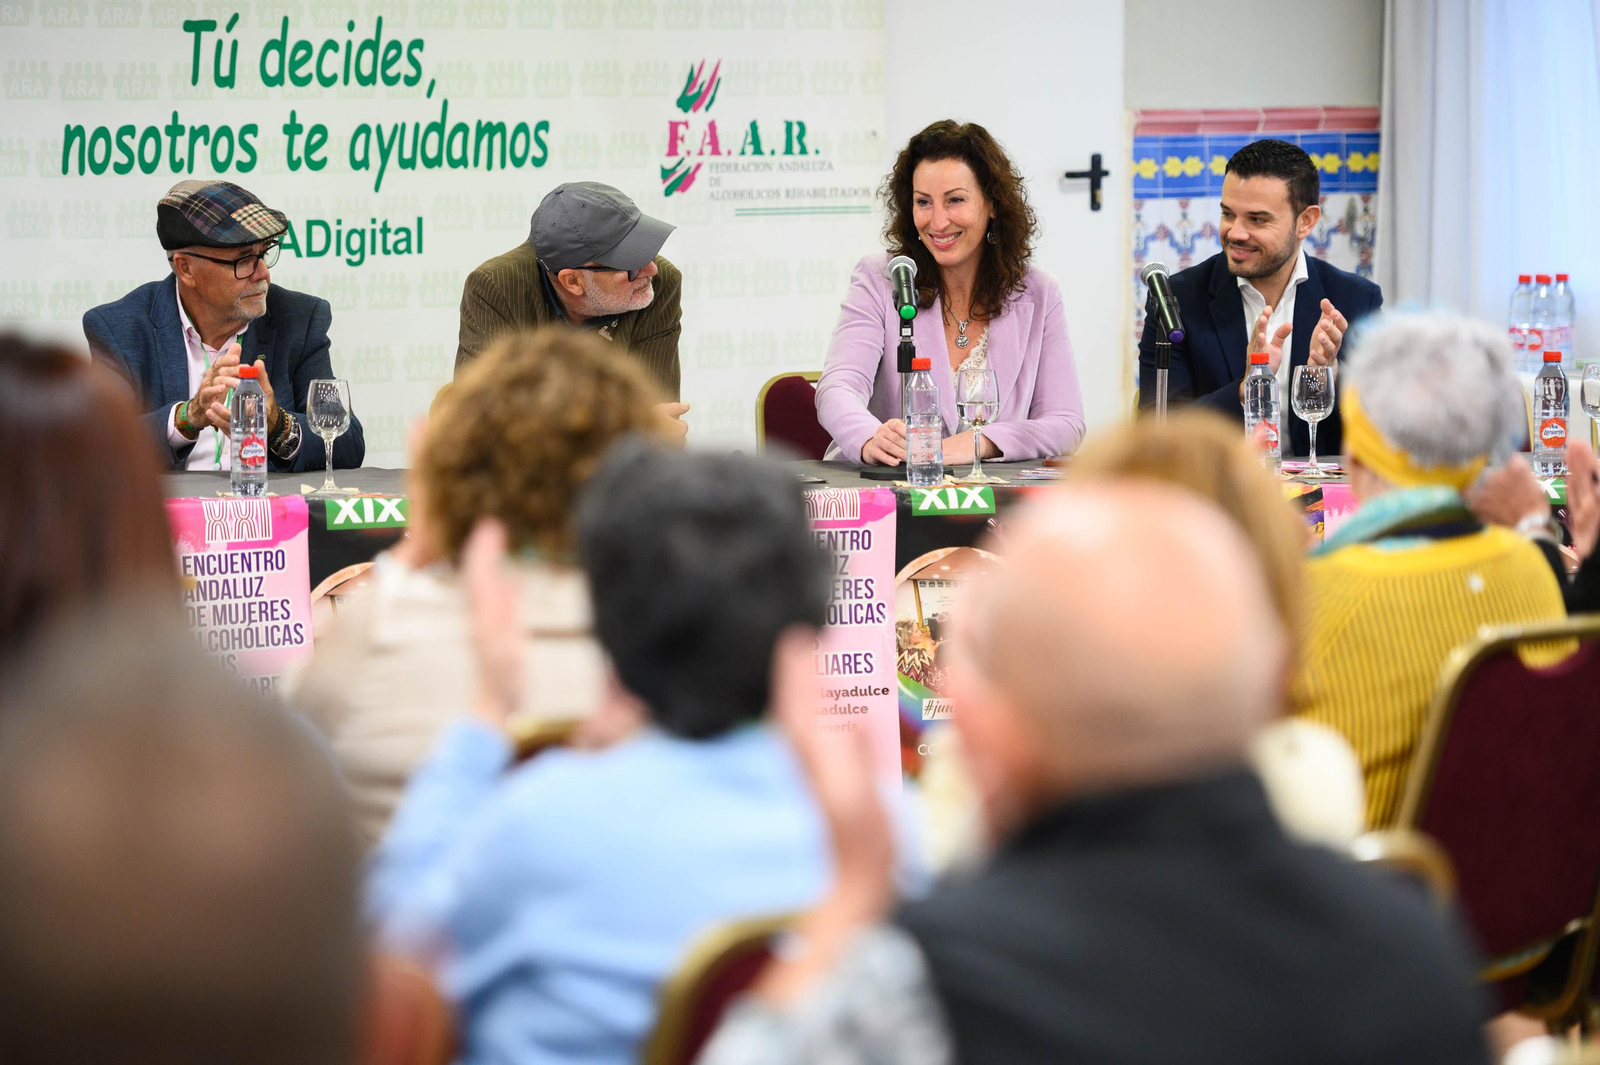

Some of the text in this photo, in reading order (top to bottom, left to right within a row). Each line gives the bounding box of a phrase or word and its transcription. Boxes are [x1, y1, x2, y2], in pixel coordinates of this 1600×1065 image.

[0, 5, 26, 23] RA
[45, 6, 81, 24] ARA
[100, 7, 135, 24] ARA
[183, 13, 437, 99] Tú decides,
[9, 78, 45, 96] ARA
[65, 79, 100, 97] ARA
[119, 79, 155, 97] ARA
[61, 98, 550, 193] nosotros te ayudamos
[709, 176, 720, 188] DE
[13, 217, 46, 235] ARA
[65, 218, 100, 235] ARA
[278, 216, 424, 267] ADigital
[917, 486, 990, 511] XIX
[332, 497, 406, 525] XIX
[811, 529, 872, 551] ENTRO
[182, 549, 286, 577] ENCUENTRO
[830, 578, 875, 602] ERES
[212, 598, 291, 626] MUJERES
[823, 600, 886, 626] ÓLICAS
[196, 621, 305, 652] LCOHÓLICAS
[814, 652, 874, 676] LIARES
[819, 685, 890, 701] layadulce
